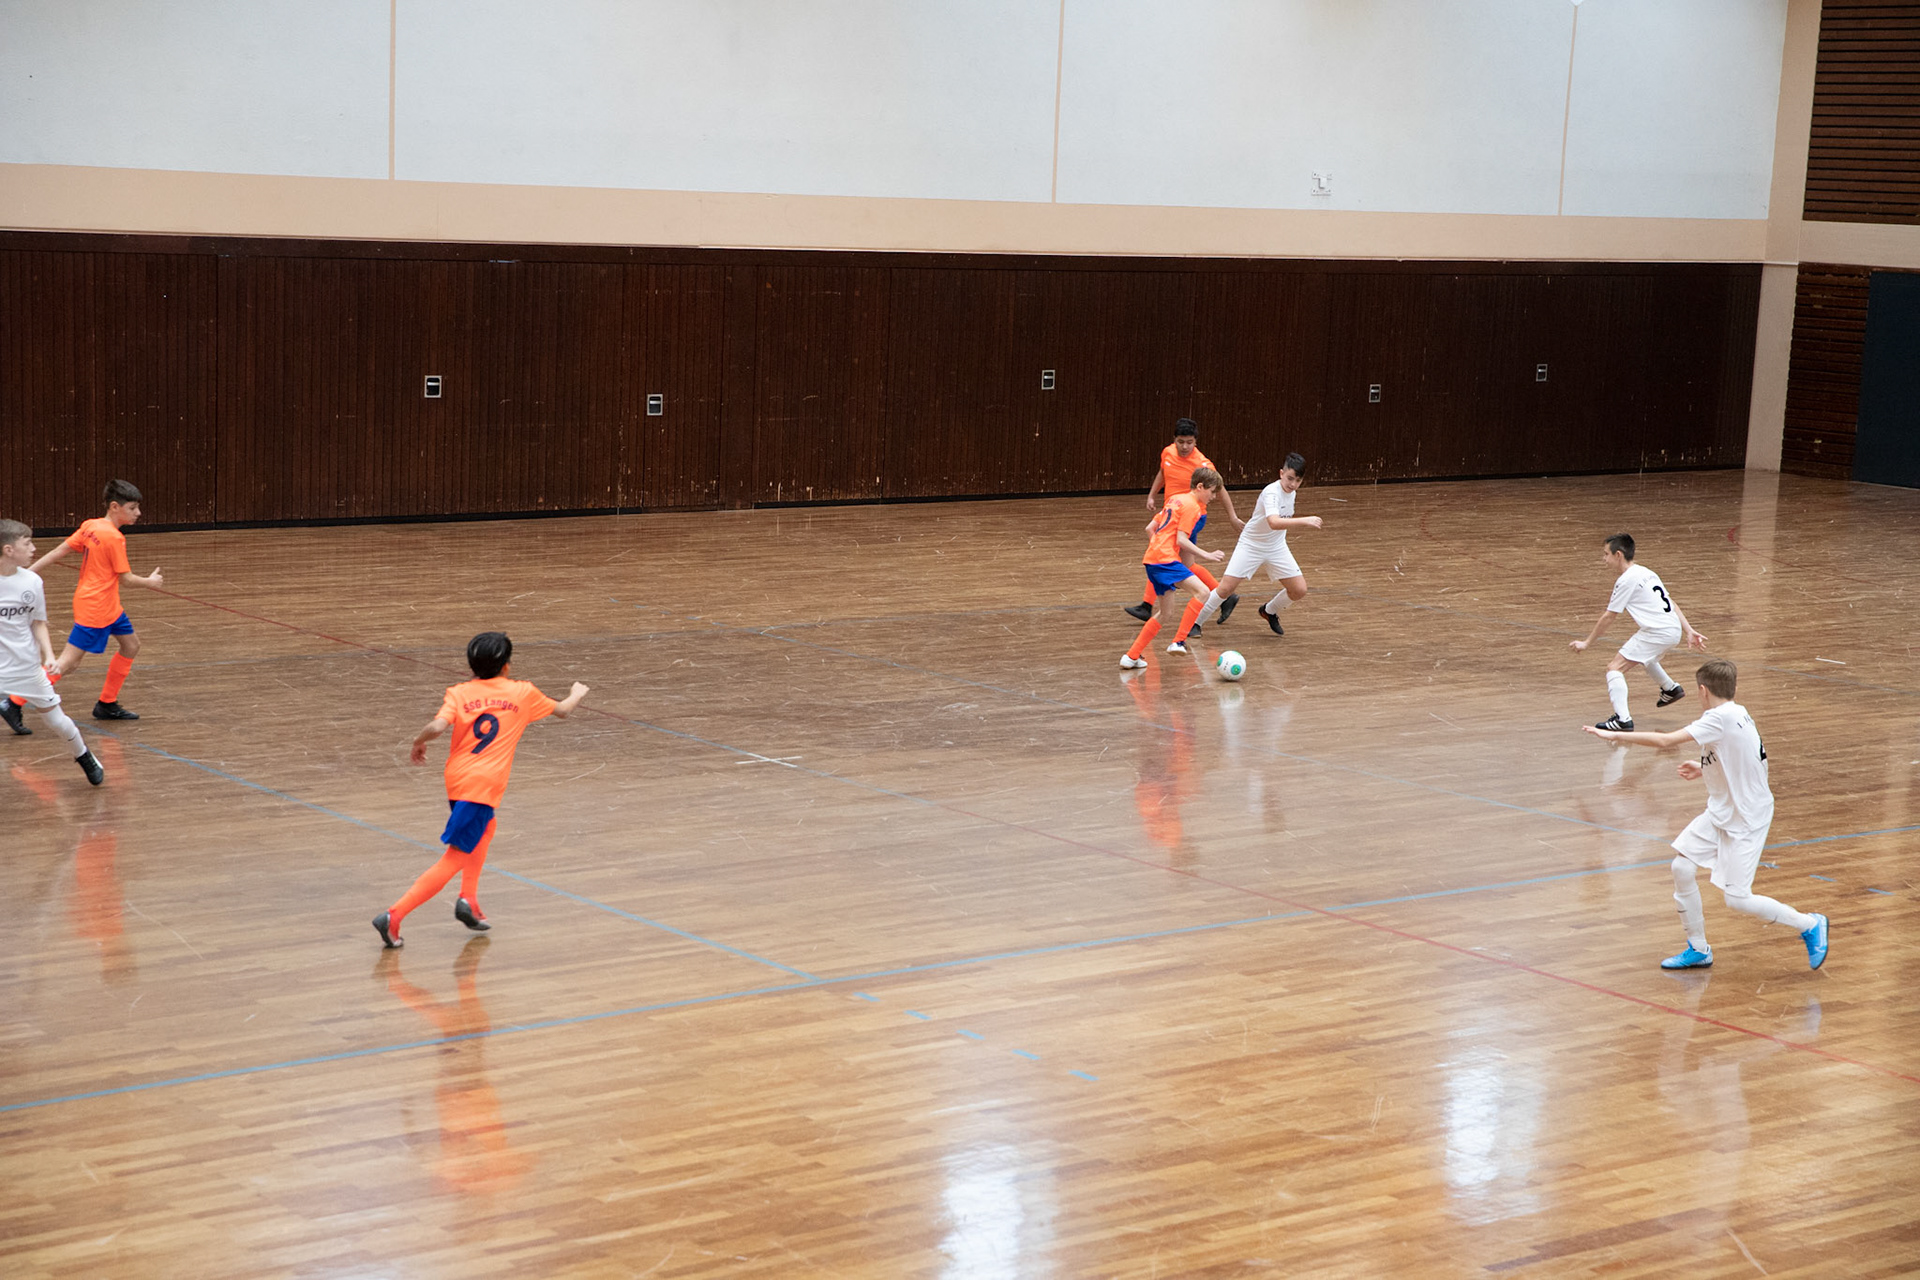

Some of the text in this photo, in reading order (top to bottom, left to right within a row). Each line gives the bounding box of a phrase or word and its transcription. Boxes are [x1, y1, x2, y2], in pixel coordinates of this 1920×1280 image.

[1652, 585, 1672, 613] 3
[463, 698, 520, 714] SSG Langen
[471, 712, 500, 754] 9
